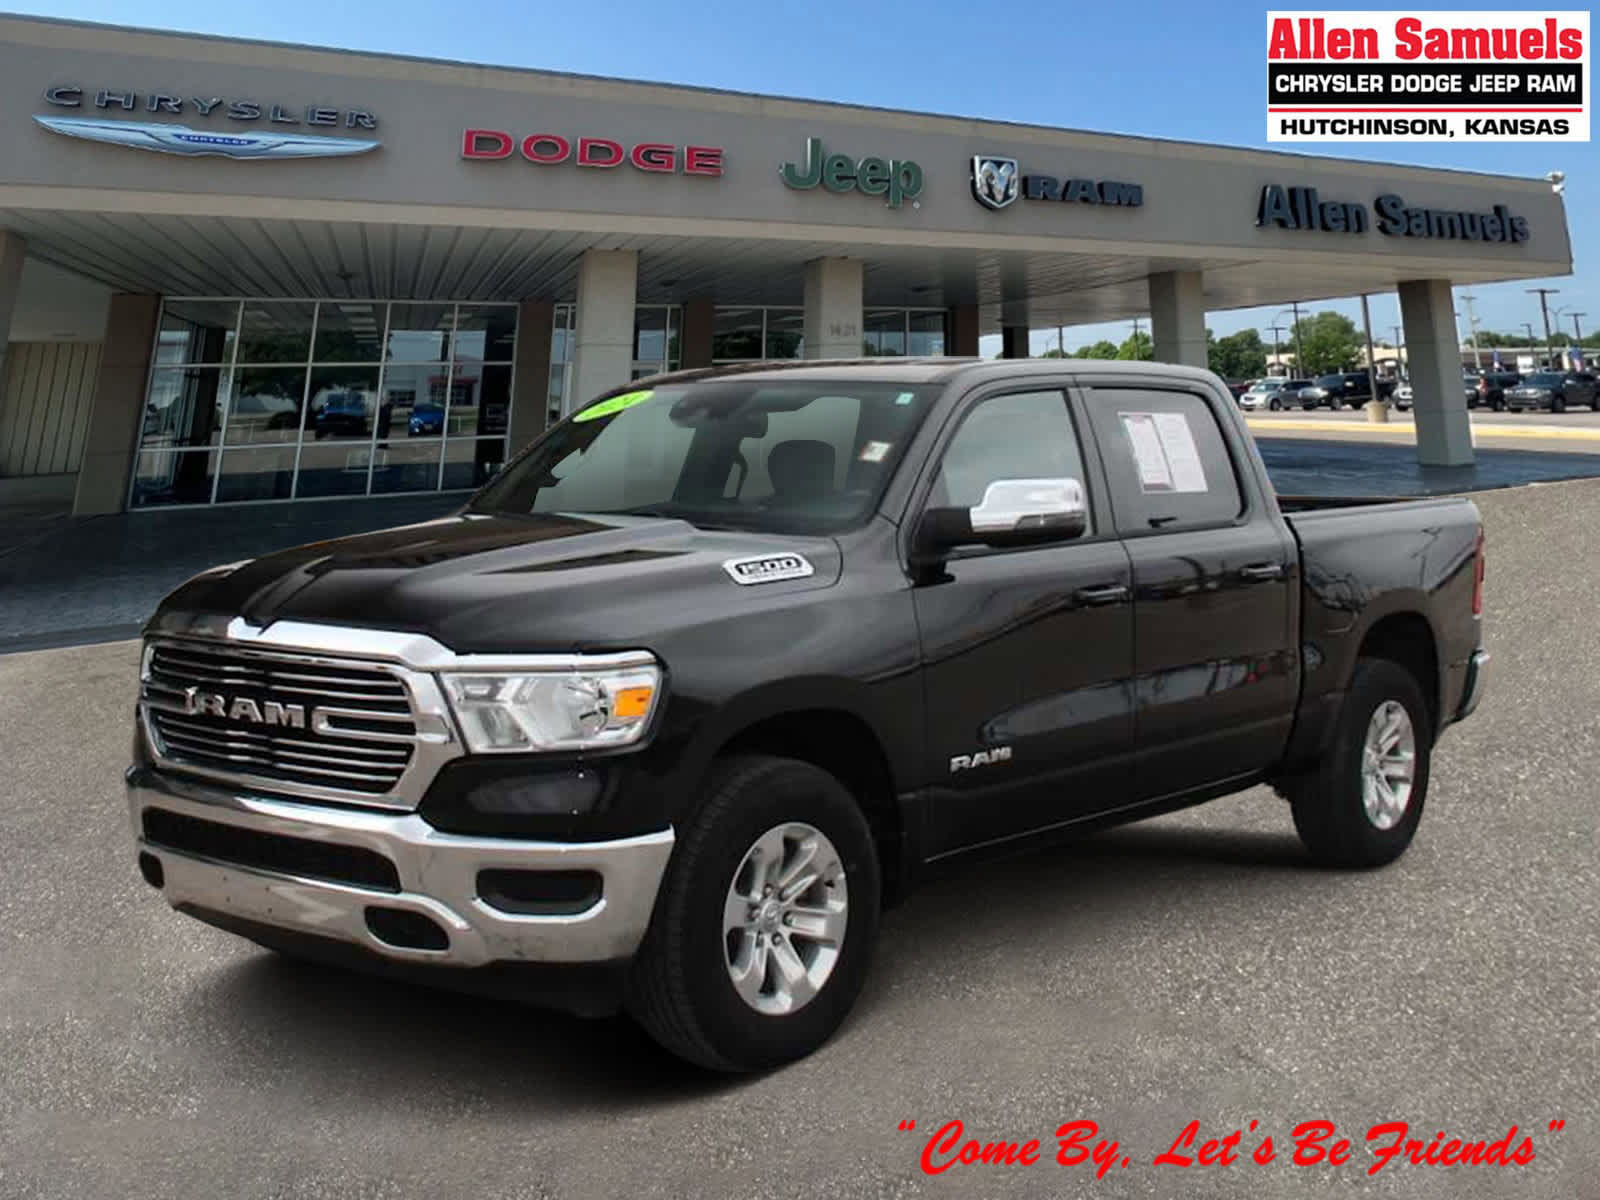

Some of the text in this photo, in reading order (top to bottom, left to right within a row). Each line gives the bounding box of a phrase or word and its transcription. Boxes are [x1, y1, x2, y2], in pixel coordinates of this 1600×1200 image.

[44, 86, 378, 128] CHRYSLER
[460, 128, 724, 176] DODGE
[780, 137, 923, 208] Jeep
[1022, 174, 1143, 207] RAM
[1256, 184, 1531, 243] Allen Samuels
[200, 694, 305, 729] RAM
[949, 746, 1012, 773] RAM
